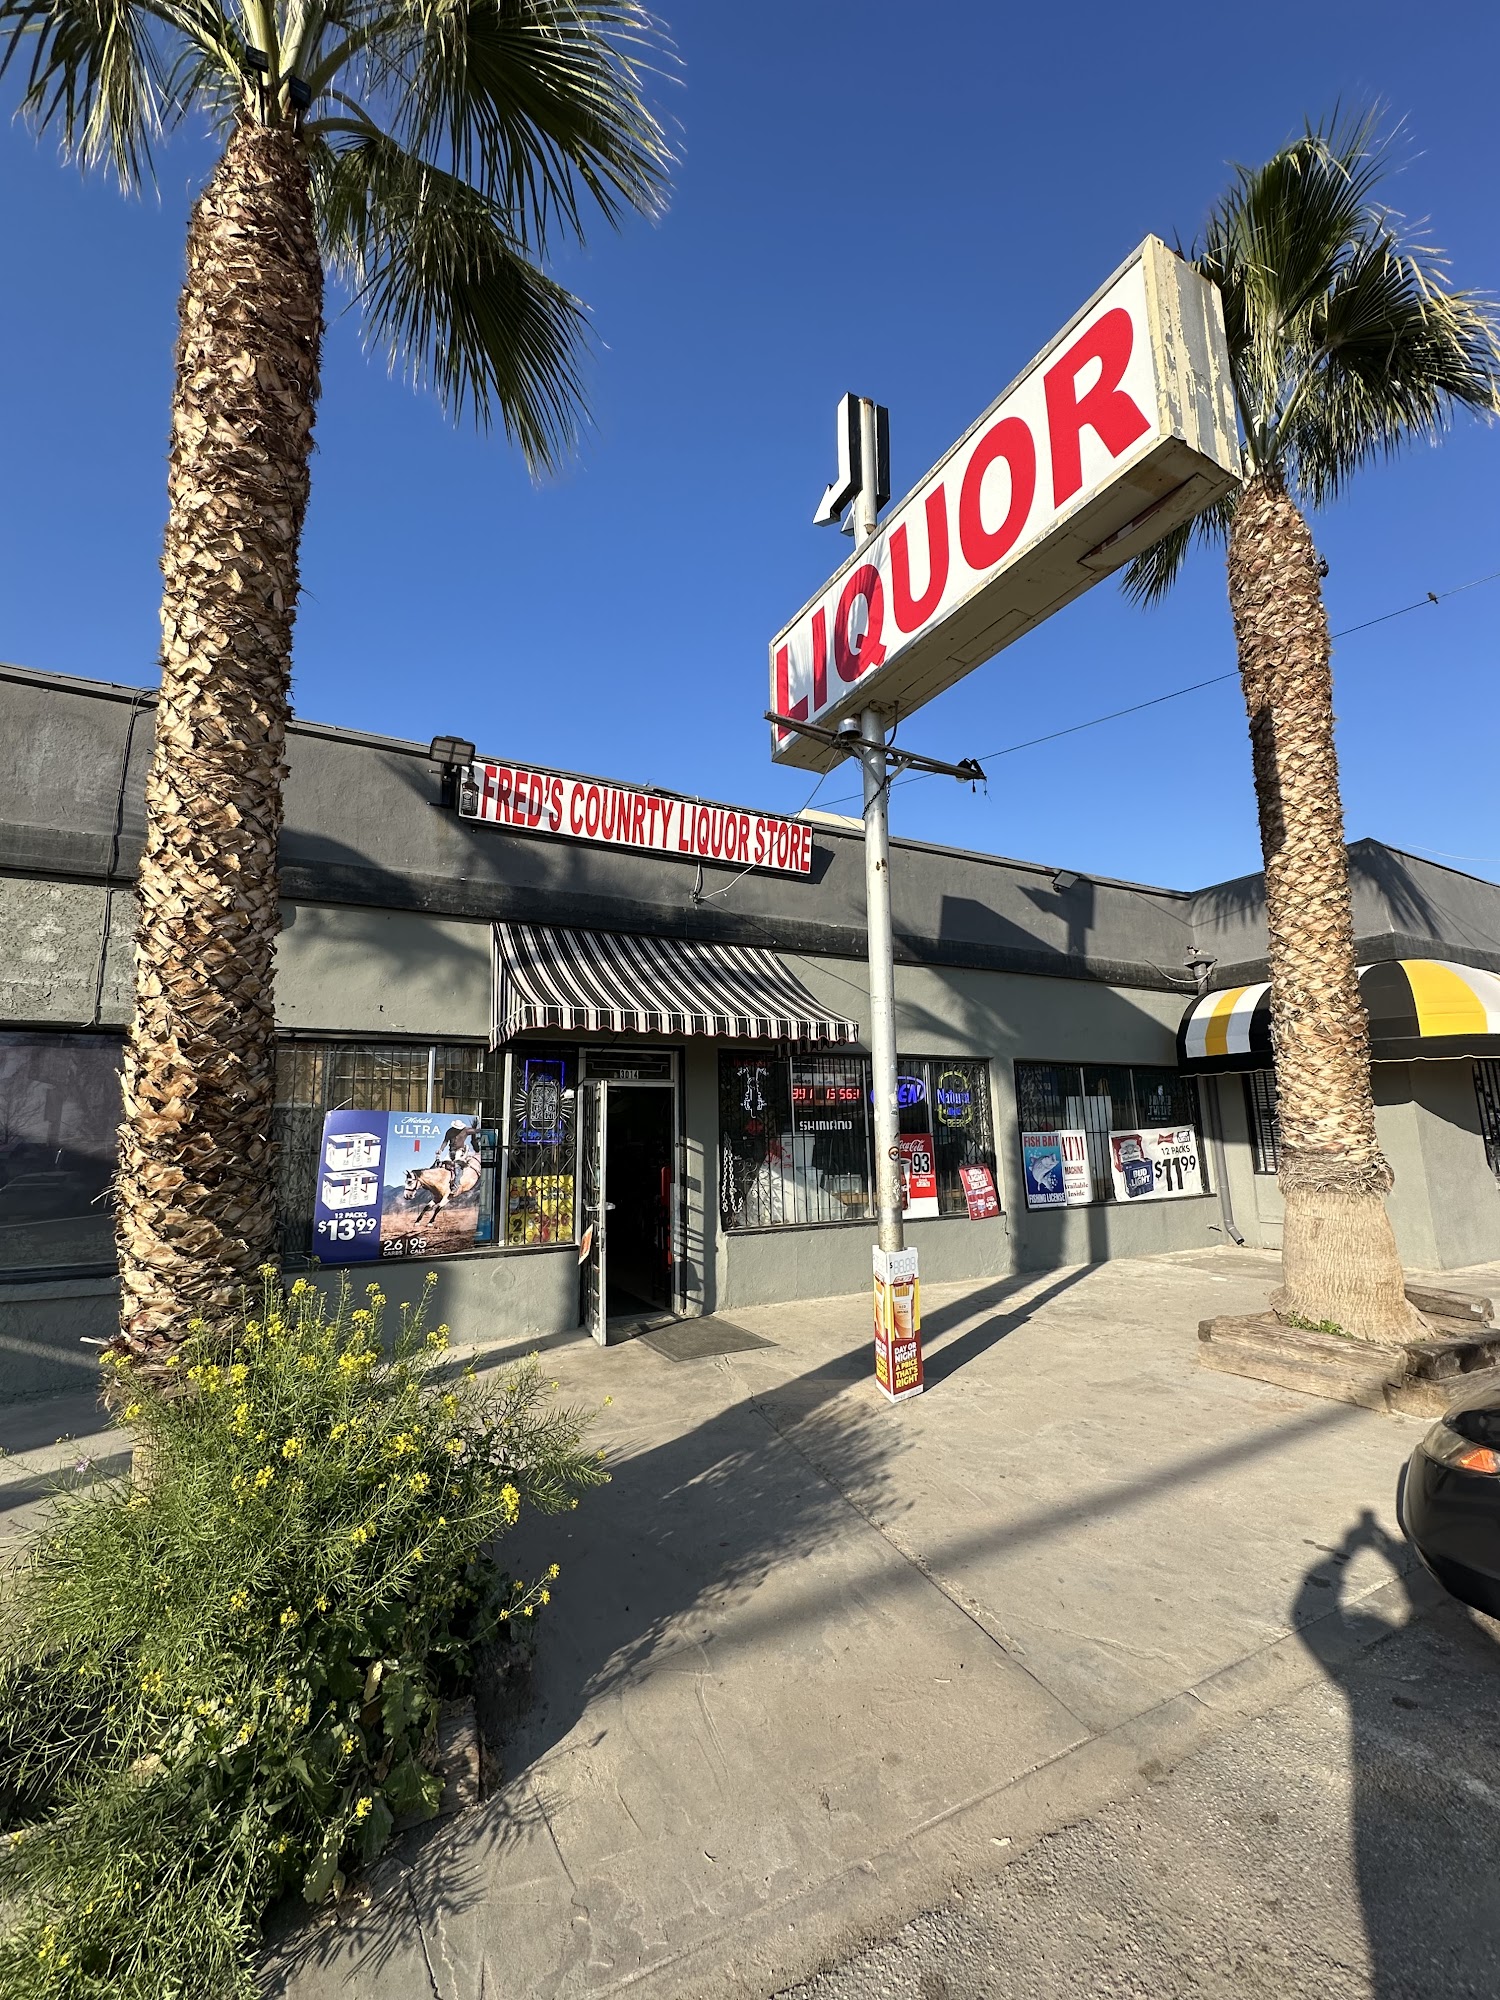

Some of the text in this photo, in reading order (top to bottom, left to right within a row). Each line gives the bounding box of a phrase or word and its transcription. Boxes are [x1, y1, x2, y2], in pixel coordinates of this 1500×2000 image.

[776, 308, 1151, 742] LIQUOR
[481, 765, 811, 871] FRED'S COUNRTY LIQUOR STORE
[620, 1070, 639, 1079] 3014
[799, 1120, 853, 1131] SHIMANO
[947, 1119, 965, 1127] BEER
[394, 1124, 441, 1135] ULTRA
[1023, 1135, 1059, 1147] FISH BAIT
[1062, 1136, 1085, 1161] ATM
[1161, 1145, 1190, 1155] 12 PACKS
[913, 1153, 930, 1173] 93
[1133, 1168, 1148, 1179] BUD
[1131, 1175, 1150, 1187] LIGHT
[1028, 1192, 1066, 1204] FISHING LICENSE
[344, 1211, 368, 1219] PACKS
[383, 1237, 427, 1251] 2.6 95
[894, 1342, 917, 1355] DAY OR
[895, 1349, 917, 1364] NIGHT
[901, 1358, 917, 1369] PRICE
[896, 1365, 918, 1379] THAT'S
[896, 1373, 918, 1388] RIGHT
